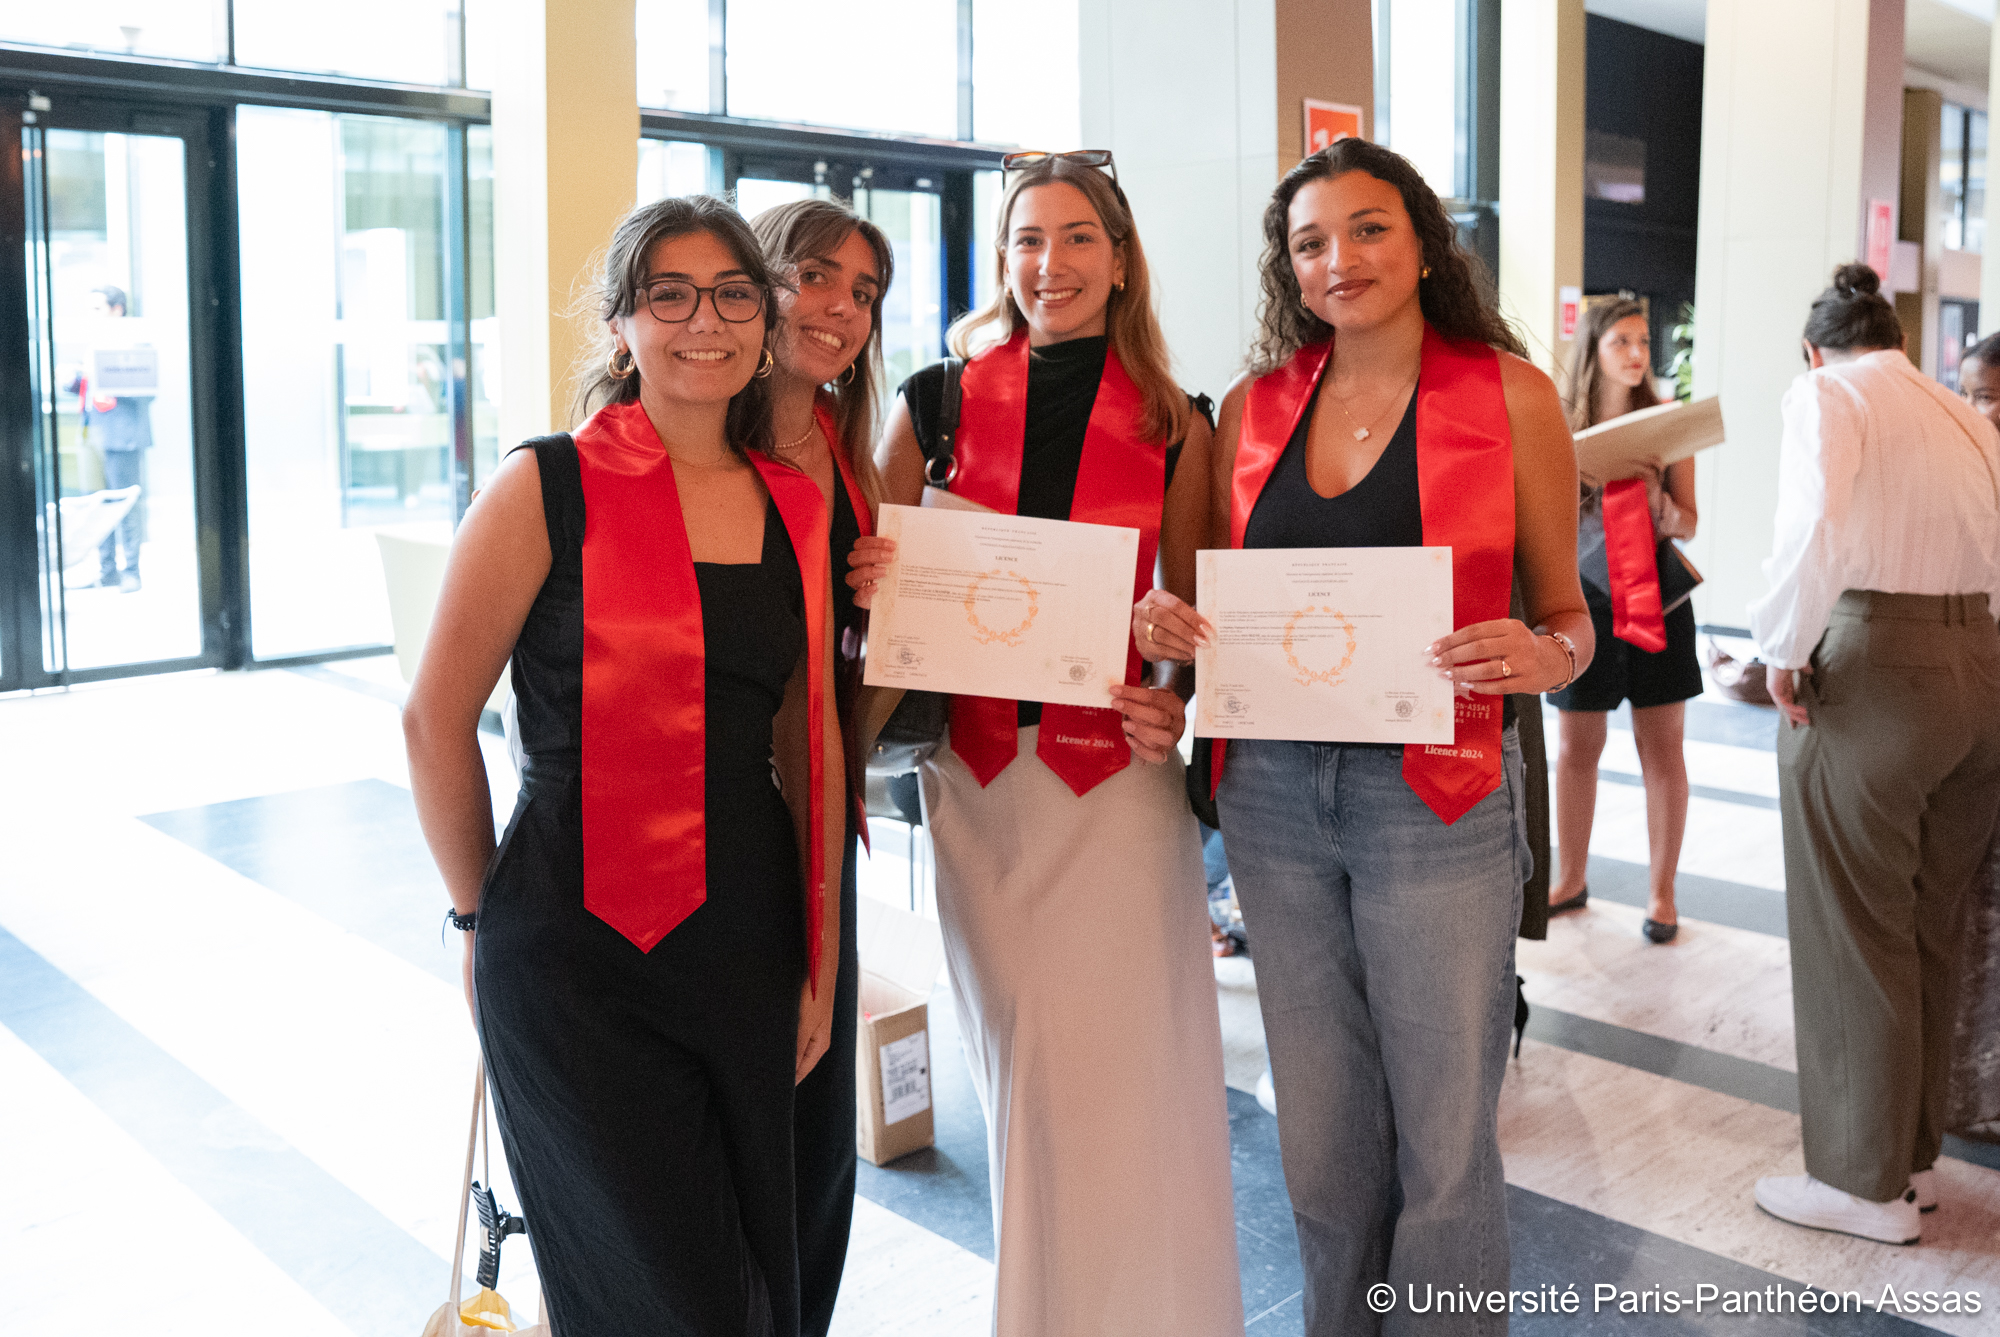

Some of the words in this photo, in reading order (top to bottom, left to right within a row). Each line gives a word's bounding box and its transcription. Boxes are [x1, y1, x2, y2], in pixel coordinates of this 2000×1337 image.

[1056, 733, 1091, 747] Licence
[1092, 738, 1115, 749] 2024
[1424, 744, 1459, 757] Licence
[1460, 748, 1484, 759] 2024
